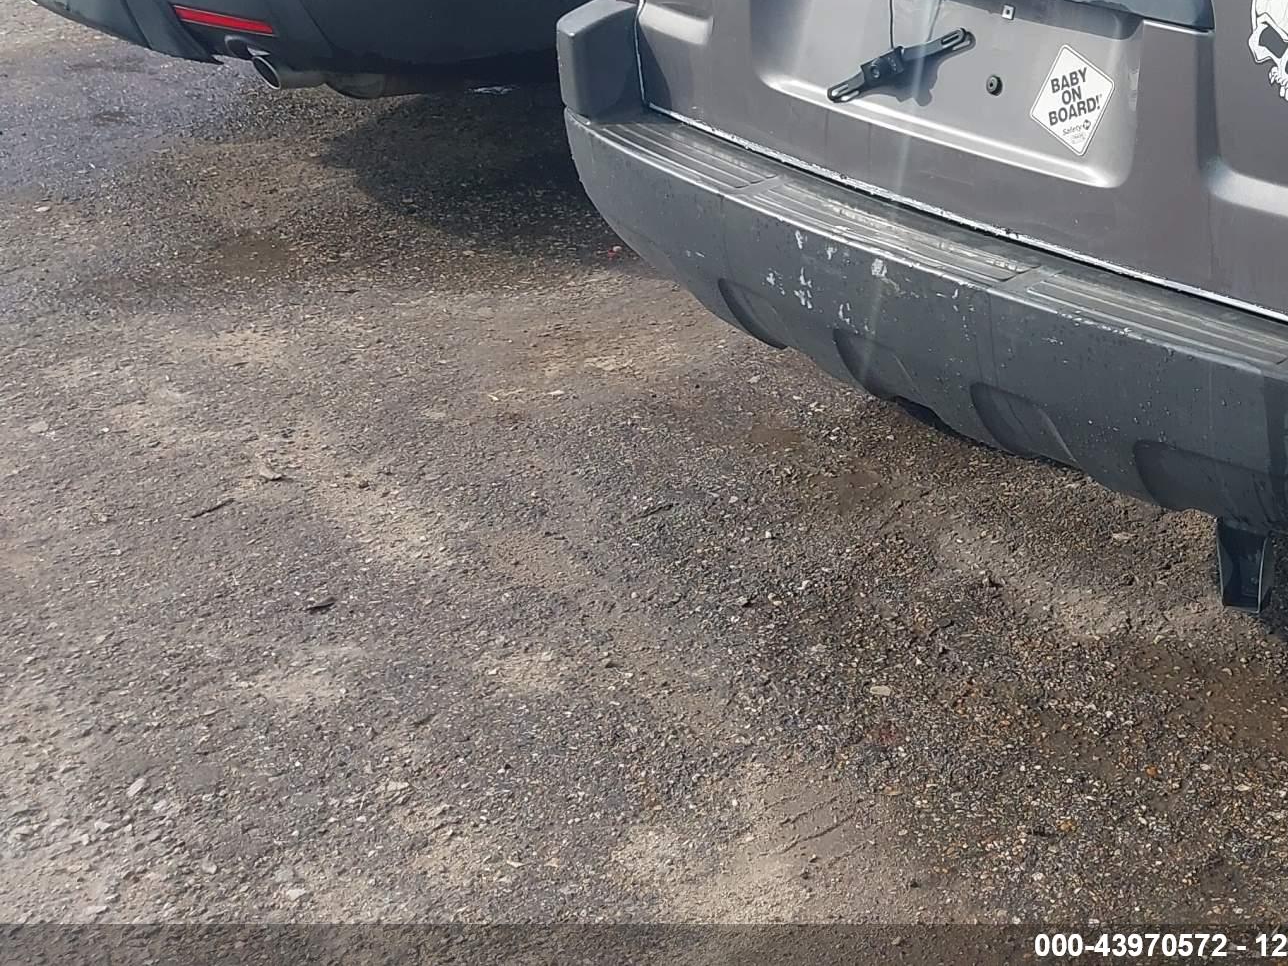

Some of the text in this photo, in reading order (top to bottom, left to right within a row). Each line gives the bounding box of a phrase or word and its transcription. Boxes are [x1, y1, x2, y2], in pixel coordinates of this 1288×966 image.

[1050, 67, 1088, 94] BABY
[1061, 85, 1082, 105] ON
[1048, 95, 1101, 126] BOARD!
